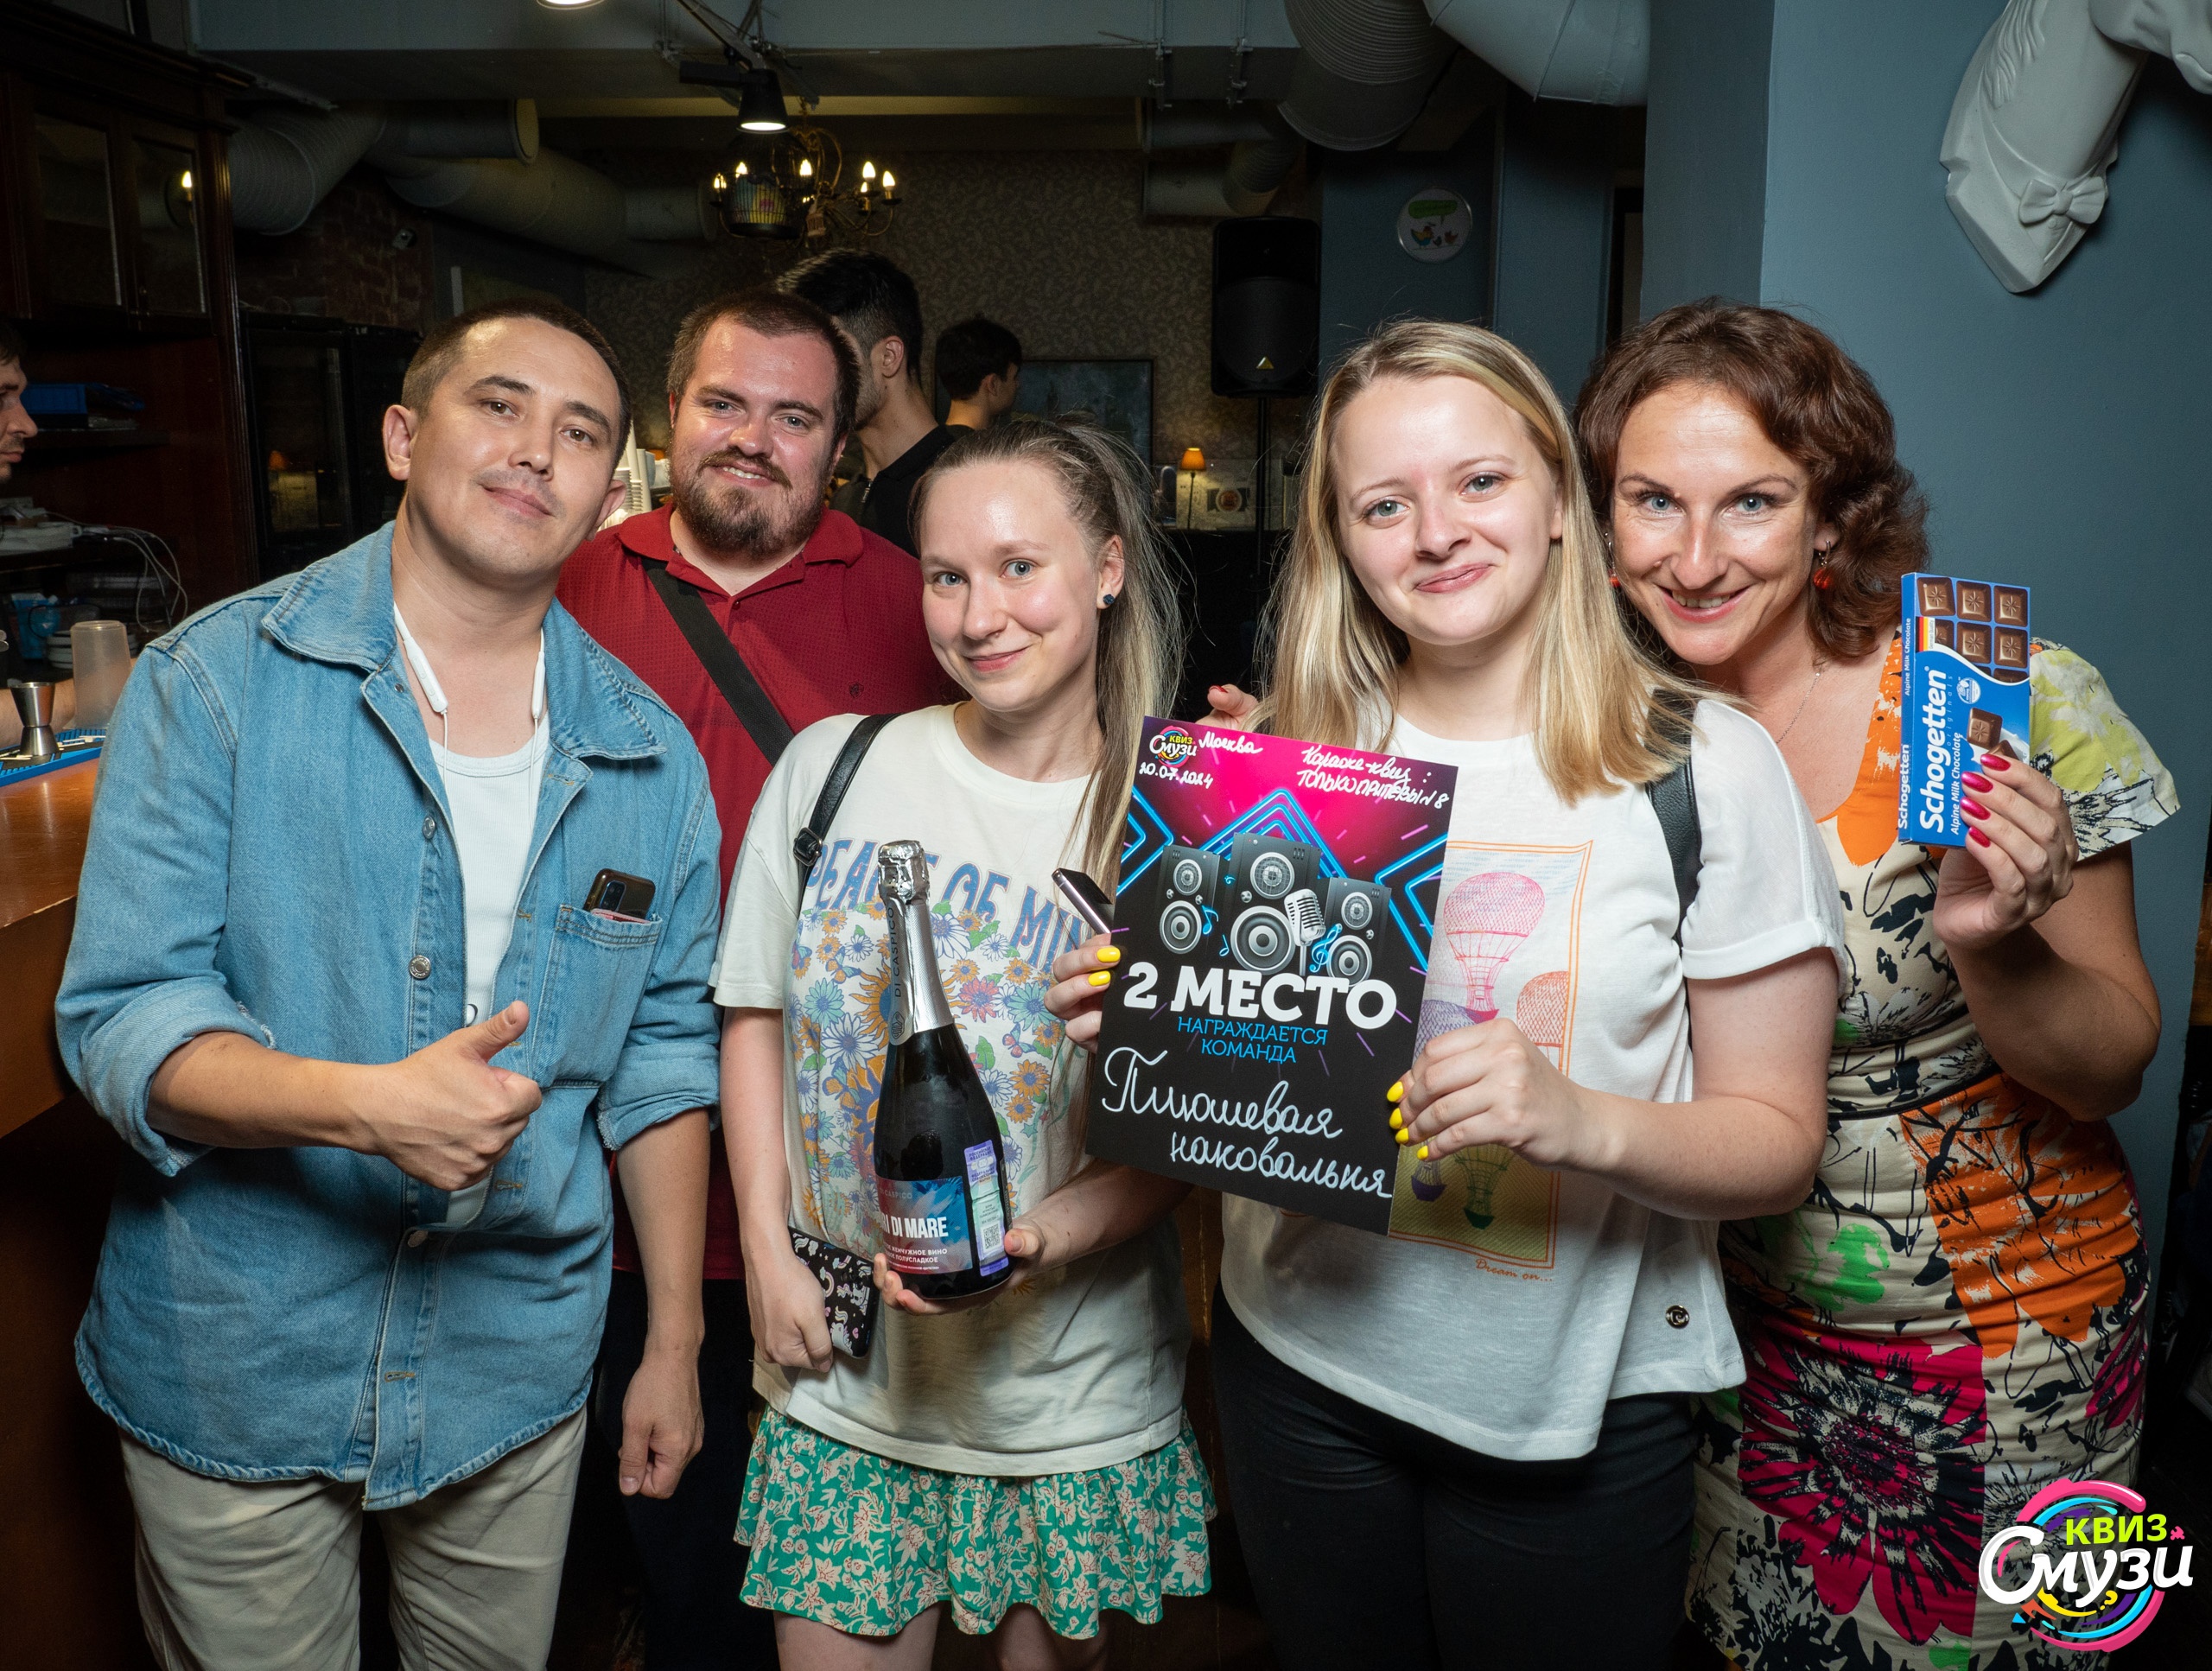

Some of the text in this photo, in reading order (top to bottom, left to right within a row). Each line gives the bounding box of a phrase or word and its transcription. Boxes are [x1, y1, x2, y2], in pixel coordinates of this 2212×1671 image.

[1149, 734, 1198, 758] Смузи
[1169, 735, 1193, 745] КВИЗ
[1198, 731, 1263, 754] Москва
[1919, 669, 1951, 833] Schogetten
[1297, 769, 1357, 792] ТОЛЬКО
[1898, 744, 1910, 829] Schogetten
[1950, 732, 1961, 836] Alpine Milk Chocolate
[941, 861, 1011, 923] OF
[887, 907, 901, 997] DI CASPICO
[1123, 962, 1397, 1030] 2 МЕСТО
[1178, 1016, 1328, 1045] НАГРАЖДАЕТСЯ
[1201, 1039, 1297, 1064] КОМАНДА
[891, 1216, 903, 1237] DI
[904, 1217, 949, 1238] MARE
[892, 1246, 926, 1255] ЖЕМЧУЖНОЕ
[895, 1255, 938, 1263] ПОЛУСЛАДКОЕ
[1476, 1258, 1517, 1278] Dream
